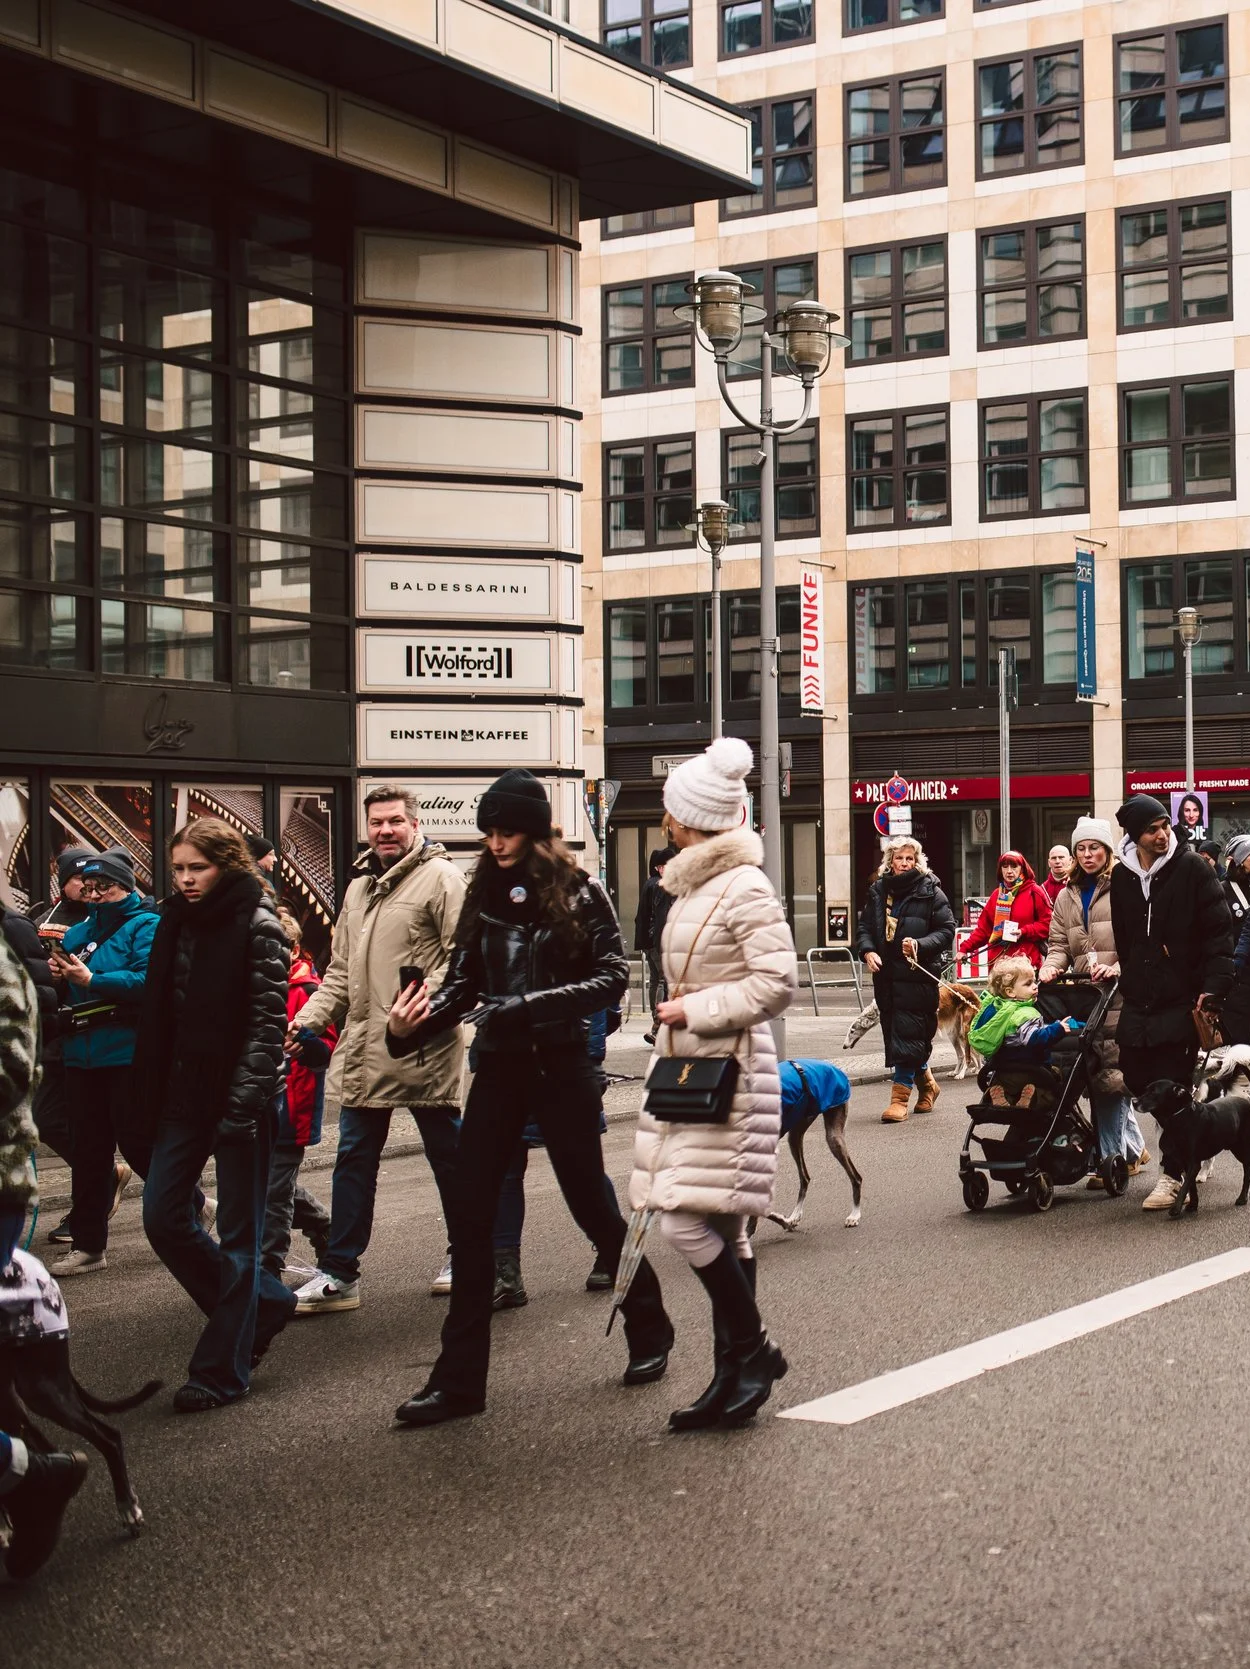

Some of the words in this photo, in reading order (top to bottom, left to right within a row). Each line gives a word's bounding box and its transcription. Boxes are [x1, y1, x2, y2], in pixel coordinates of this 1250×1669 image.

[390, 582, 527, 594] BALDESSARINI
[803, 573, 819, 668] FUNKE
[424, 653, 495, 671] Wolford
[390, 730, 459, 740] EINSTEIN
[475, 730, 529, 741] KAFFEE
[906, 781, 947, 801] MANGER
[1131, 782, 1162, 790] ORGANIC
[1163, 780, 1188, 790] COFFEE
[1199, 779, 1228, 788] FRESHLY
[1228, 779, 1249, 787] MADE
[417, 796, 465, 814] aling
[419, 818, 475, 826] AIMASSAG
[1187, 825, 1207, 841] olt
